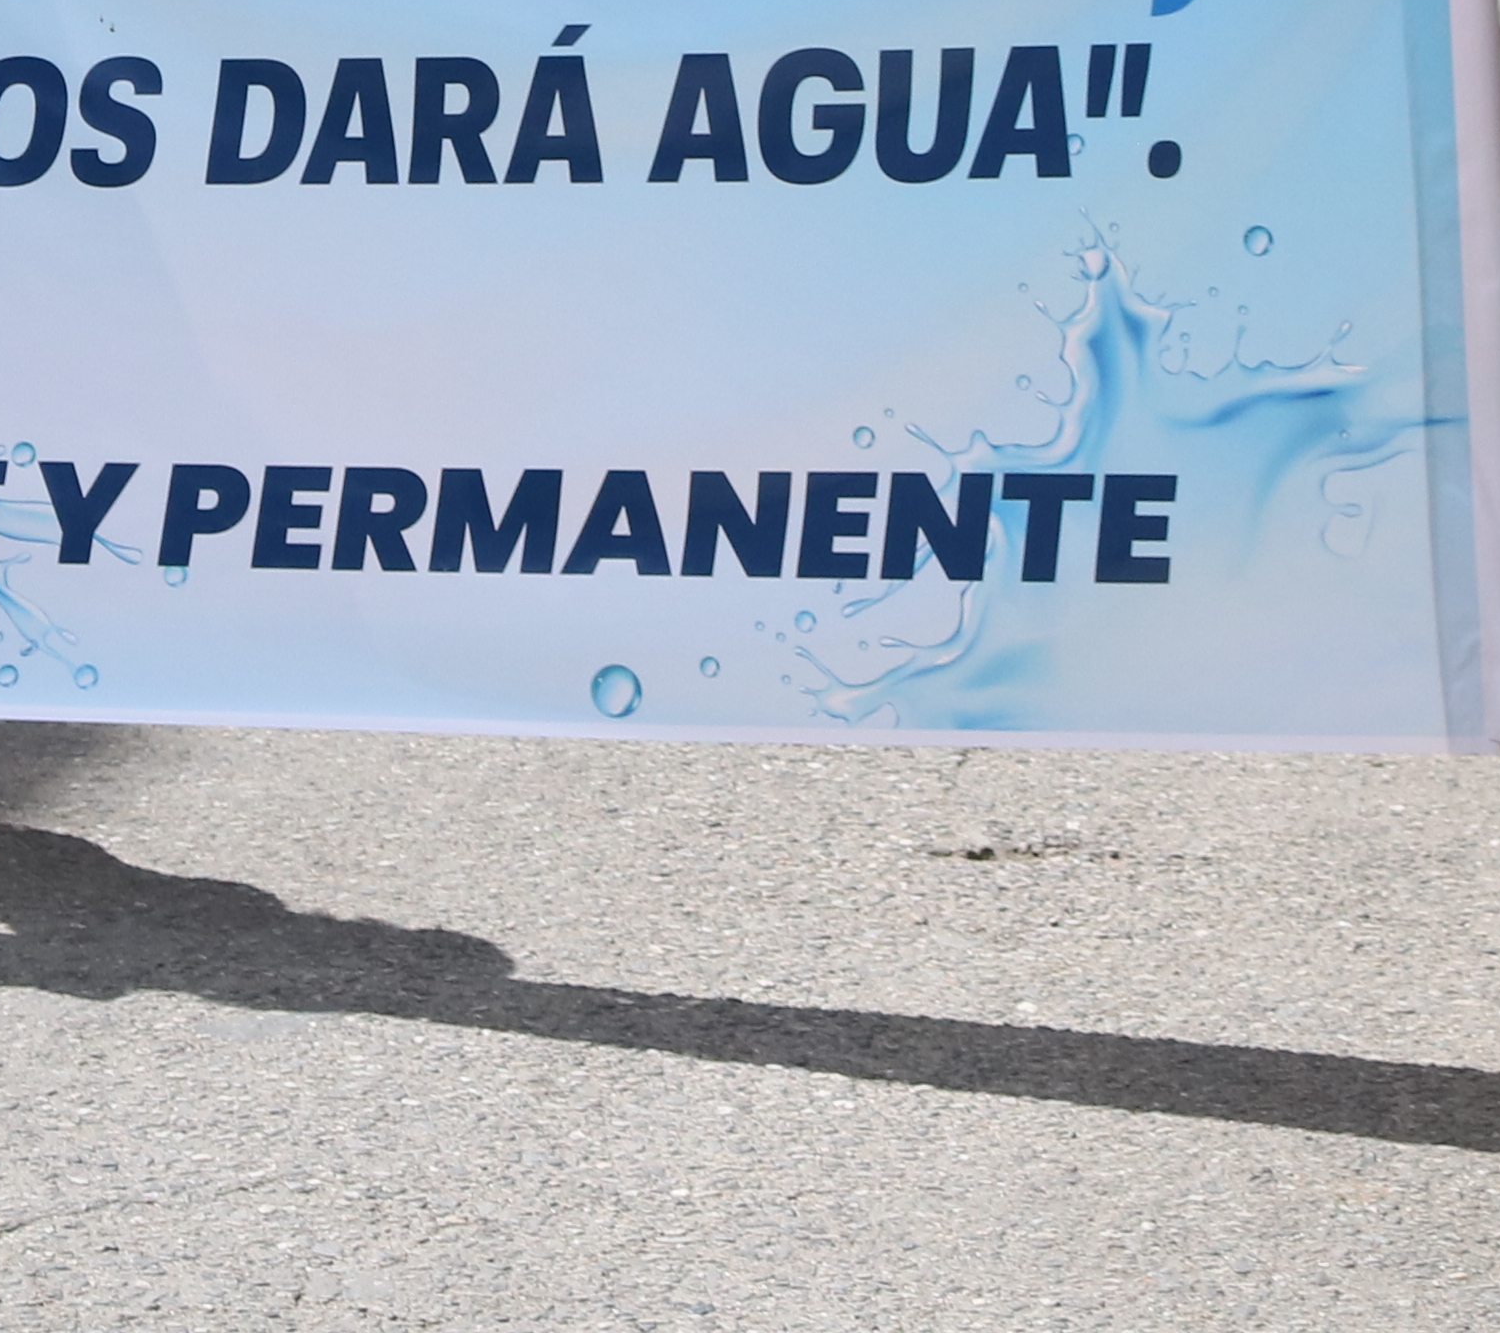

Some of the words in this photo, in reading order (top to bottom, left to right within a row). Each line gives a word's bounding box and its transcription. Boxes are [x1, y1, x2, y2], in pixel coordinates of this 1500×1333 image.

[205, 23, 605, 185] DARÁ
[647, 42, 1186, 186] AGUA".
[38, 460, 141, 565] Y
[157, 463, 1179, 584] PERMANENTE
